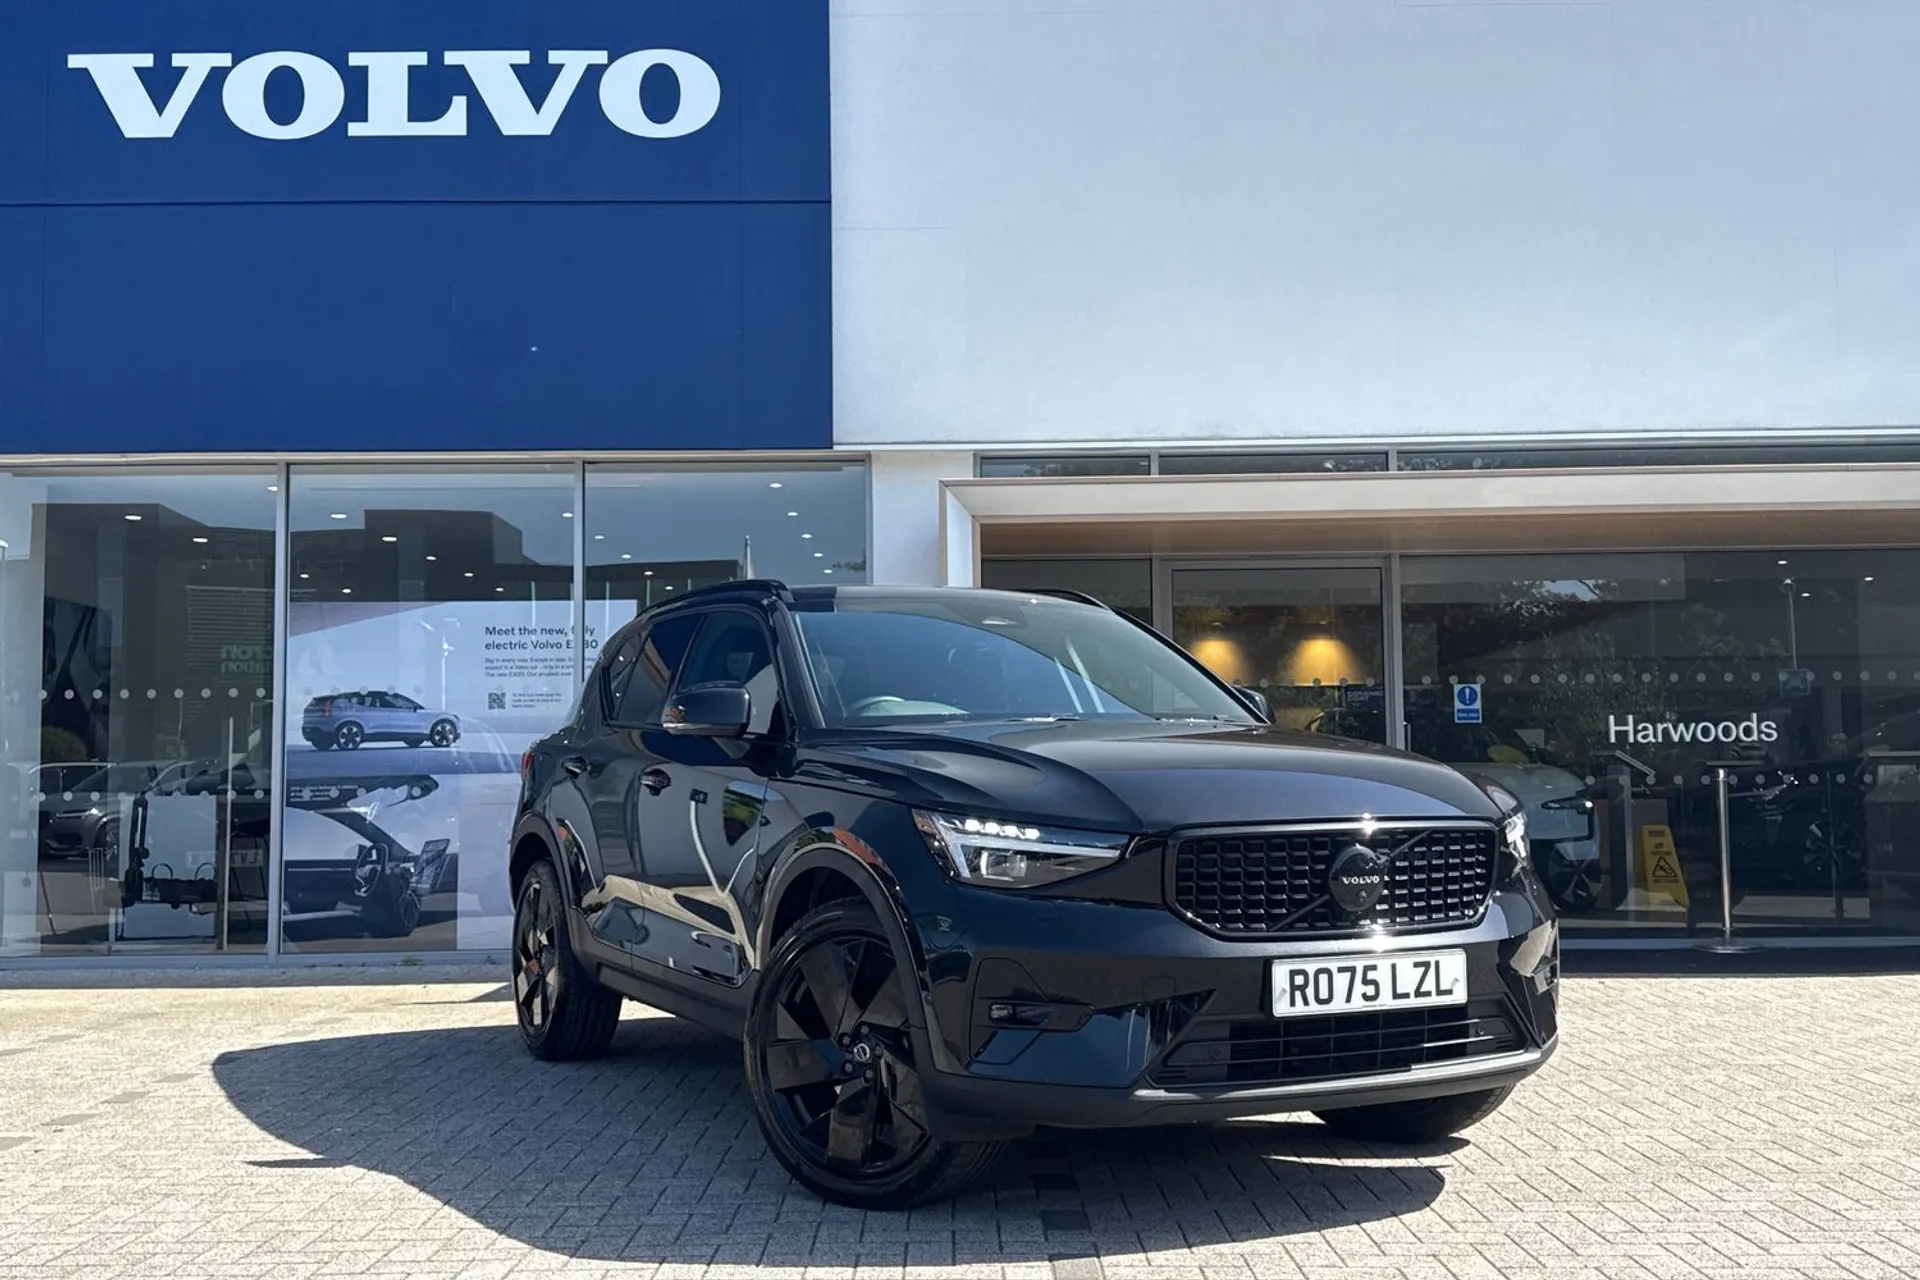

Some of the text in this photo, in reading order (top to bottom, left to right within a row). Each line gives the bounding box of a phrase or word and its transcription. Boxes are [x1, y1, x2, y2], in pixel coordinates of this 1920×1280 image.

[68, 48, 720, 140] VOLVO
[485, 626, 515, 636] Meet
[519, 626, 537, 636] the
[540, 627, 568, 637] new,
[485, 639, 598, 650] electric Volvo E30
[1608, 712, 1778, 743] Harwoods
[1342, 875, 1380, 884] VOLVO
[1289, 960, 1454, 1007] RO75 LZL
